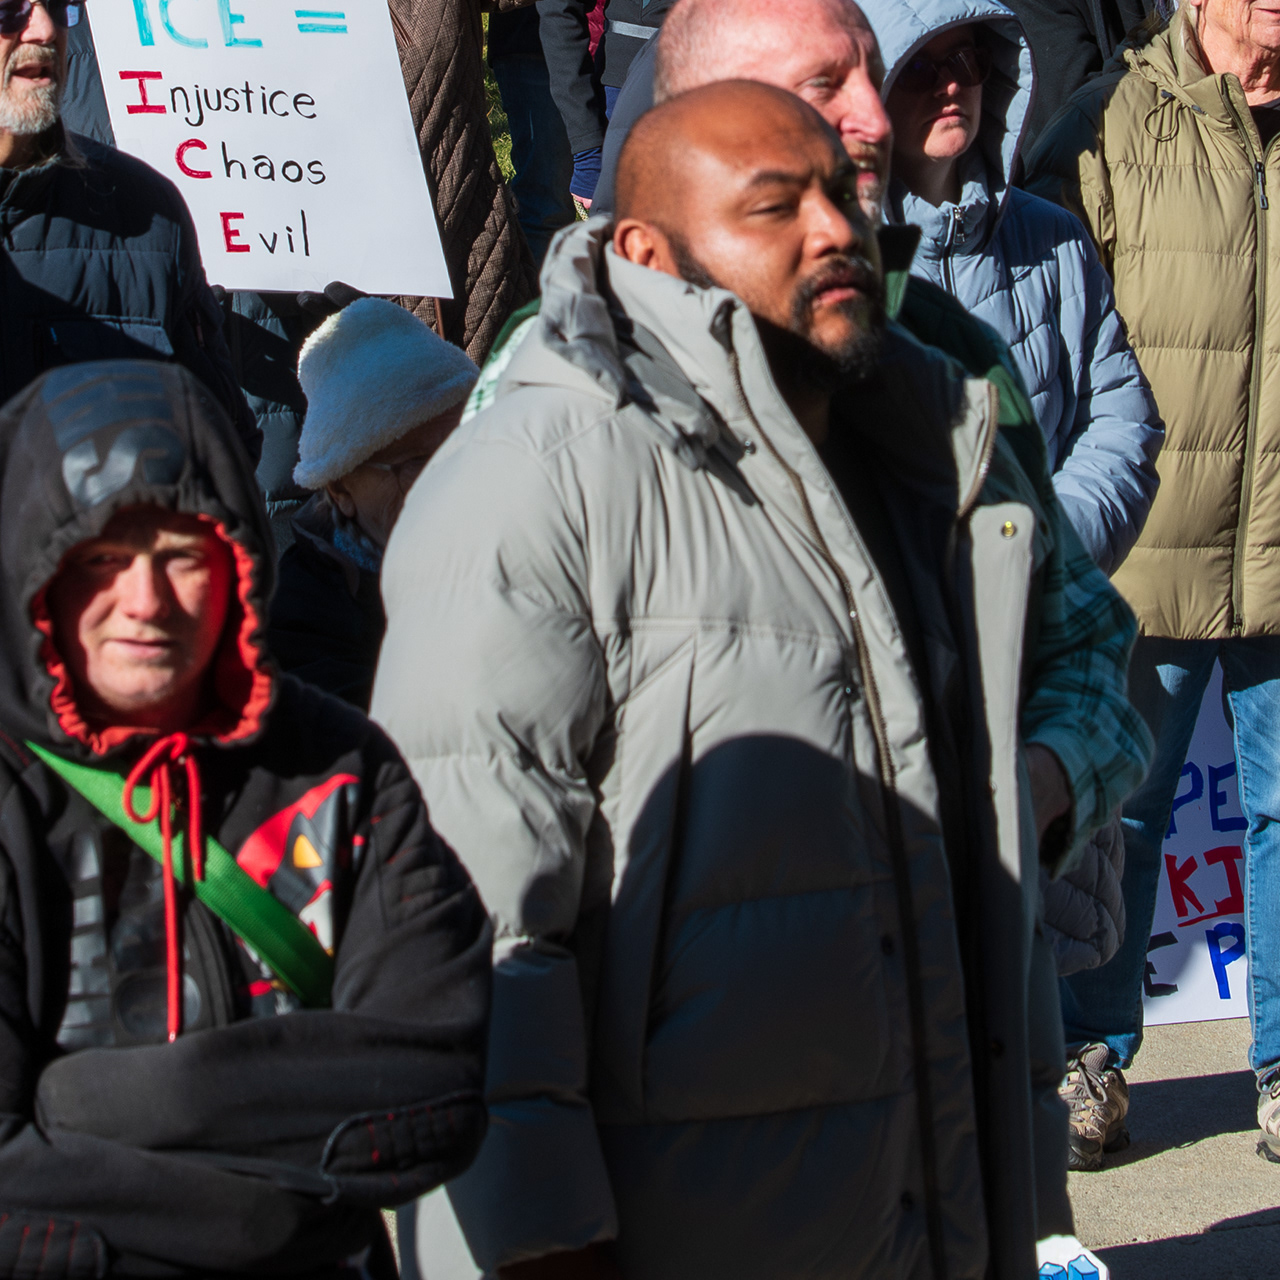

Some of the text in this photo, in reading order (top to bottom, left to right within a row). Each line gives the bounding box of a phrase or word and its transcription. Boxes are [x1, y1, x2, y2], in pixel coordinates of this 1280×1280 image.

[294, 9, 348, 34] =
[118, 70, 317, 127] Injustice
[174, 138, 327, 185] Chaos
[219, 209, 310, 257] Evil
